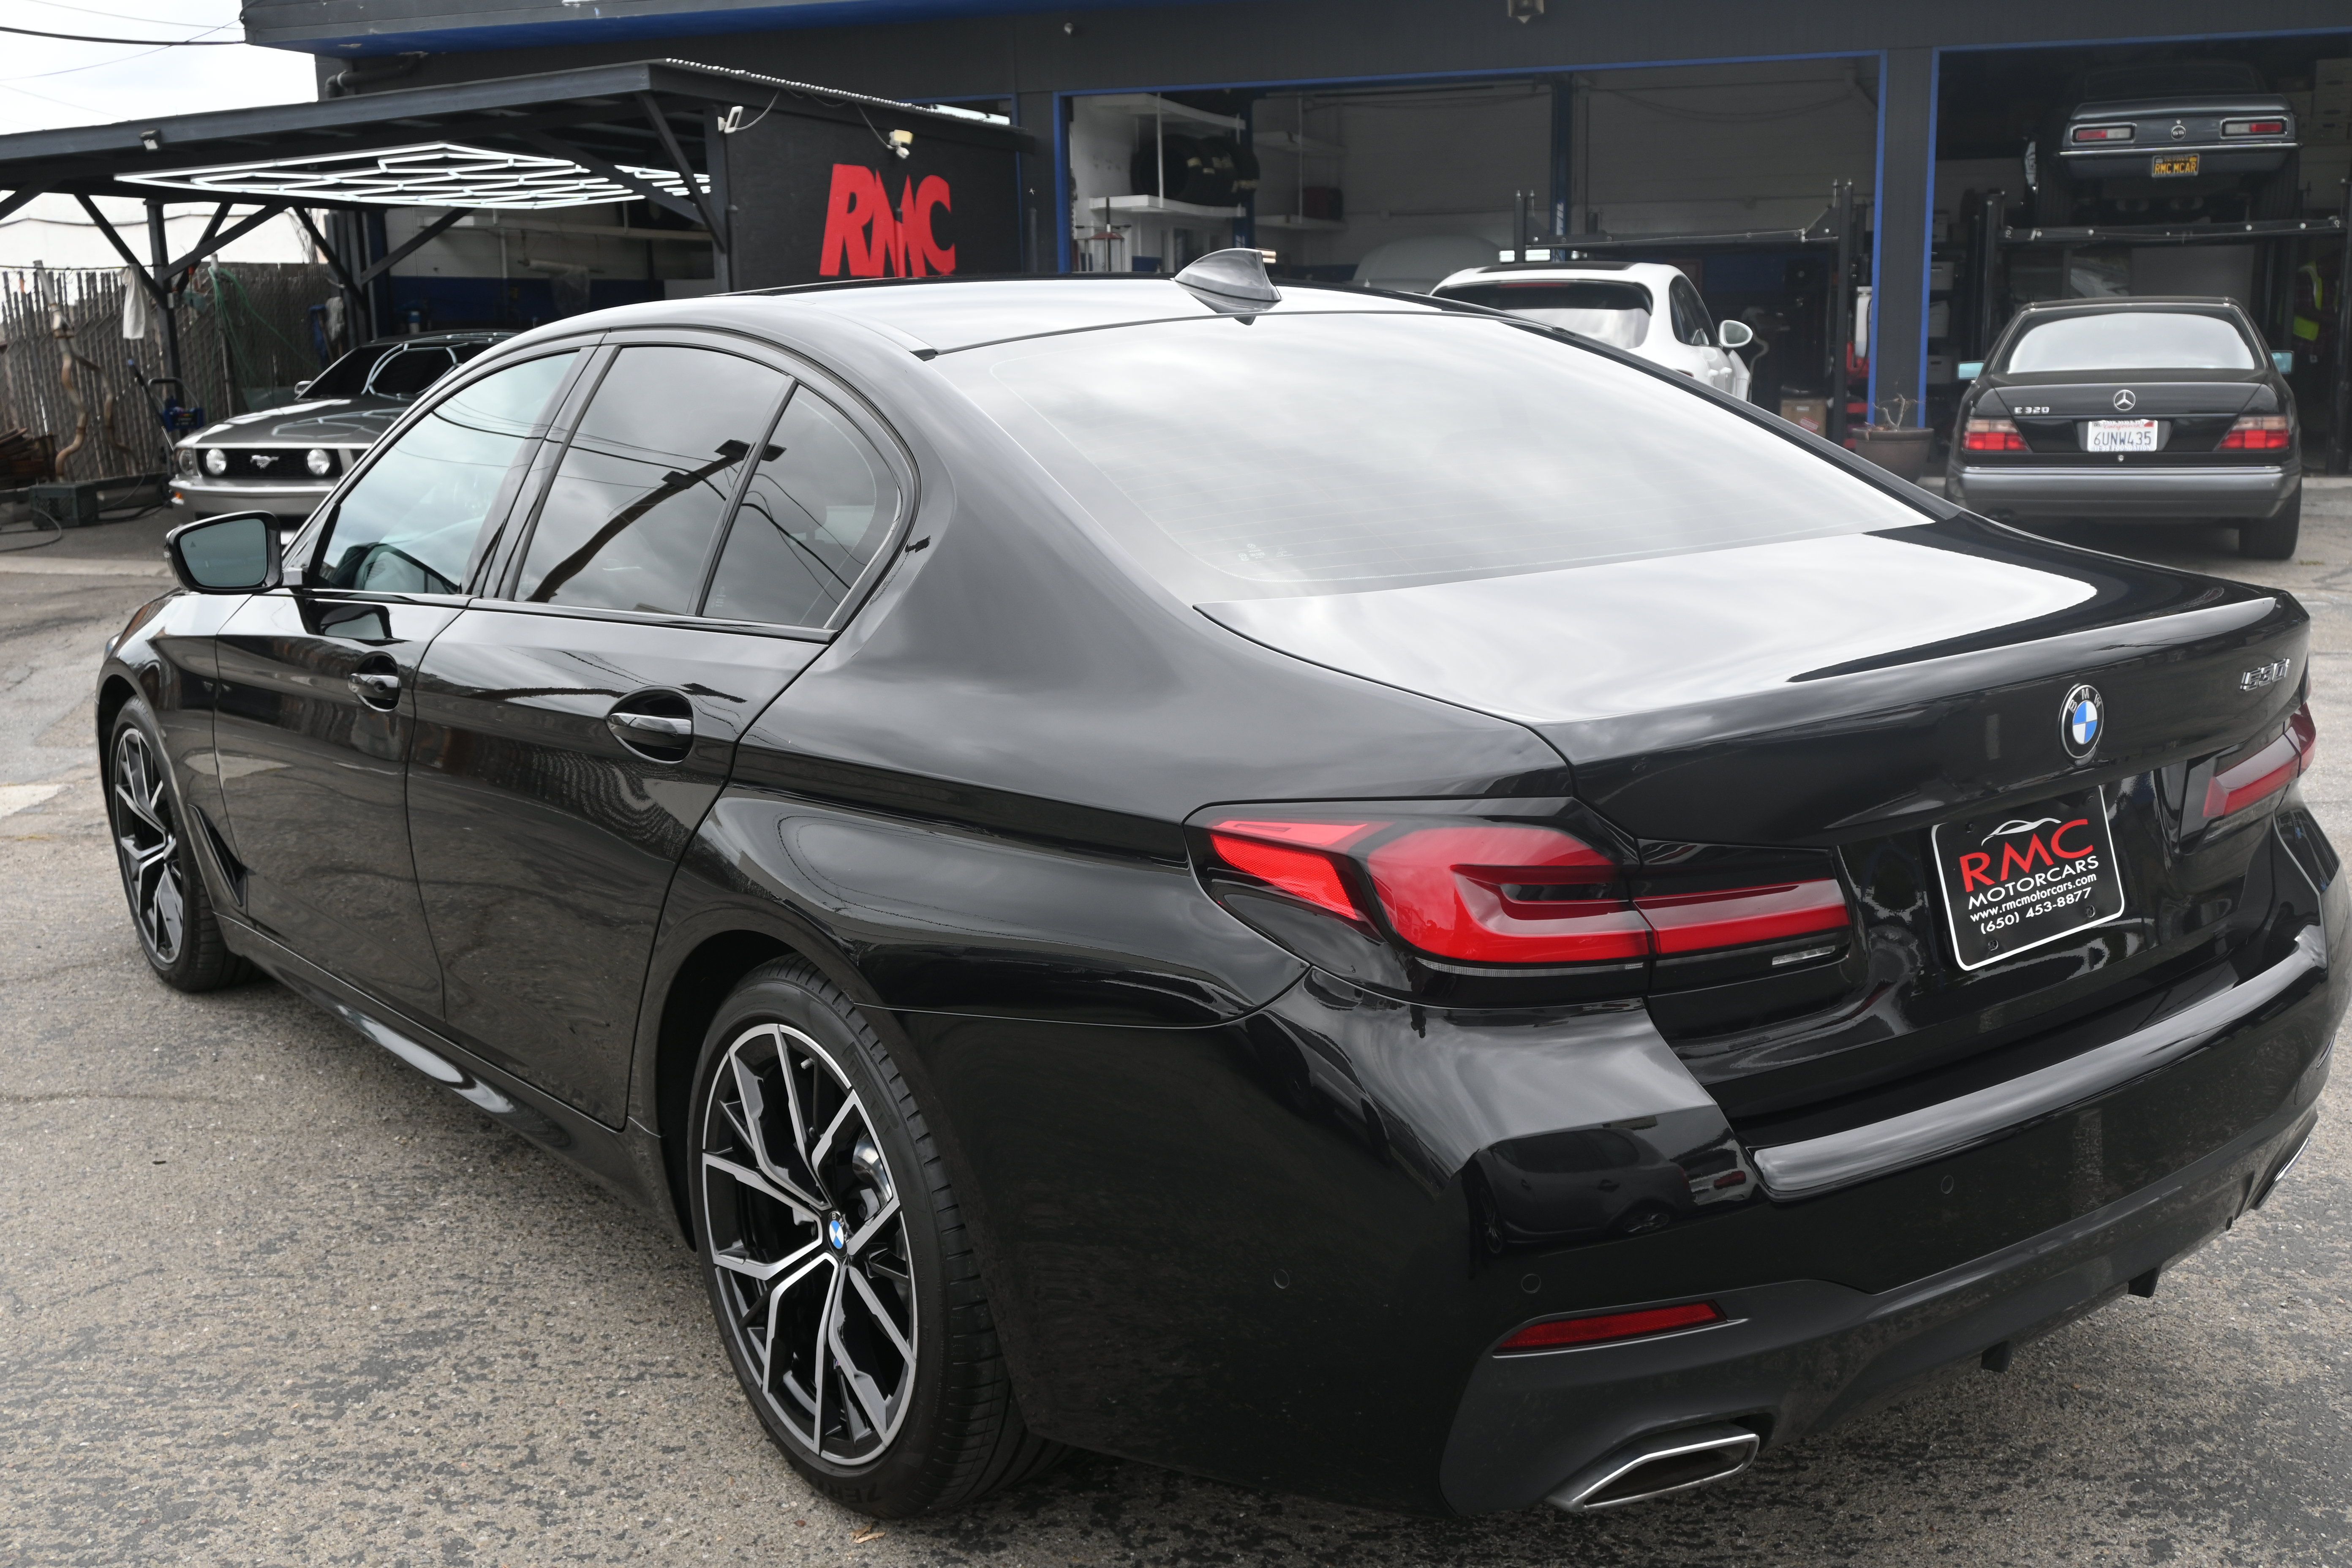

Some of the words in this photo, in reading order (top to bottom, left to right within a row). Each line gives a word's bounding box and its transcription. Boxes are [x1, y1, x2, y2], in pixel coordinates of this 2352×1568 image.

[2155, 163, 2172, 174] RMC
[2174, 162, 2197, 174] MCAR
[819, 163, 956, 278] RMC
[2094, 431, 2151, 445] 6UNW435
[2068, 688, 2102, 713] BMW
[1959, 819, 2094, 893] RMC
[1968, 855, 2099, 910] MOTORCARS
[1970, 873, 2097, 922] www.rmcmotorcars.com
[1981, 912, 2019, 935] (650)
[2026, 887, 2091, 918] 453-8877
